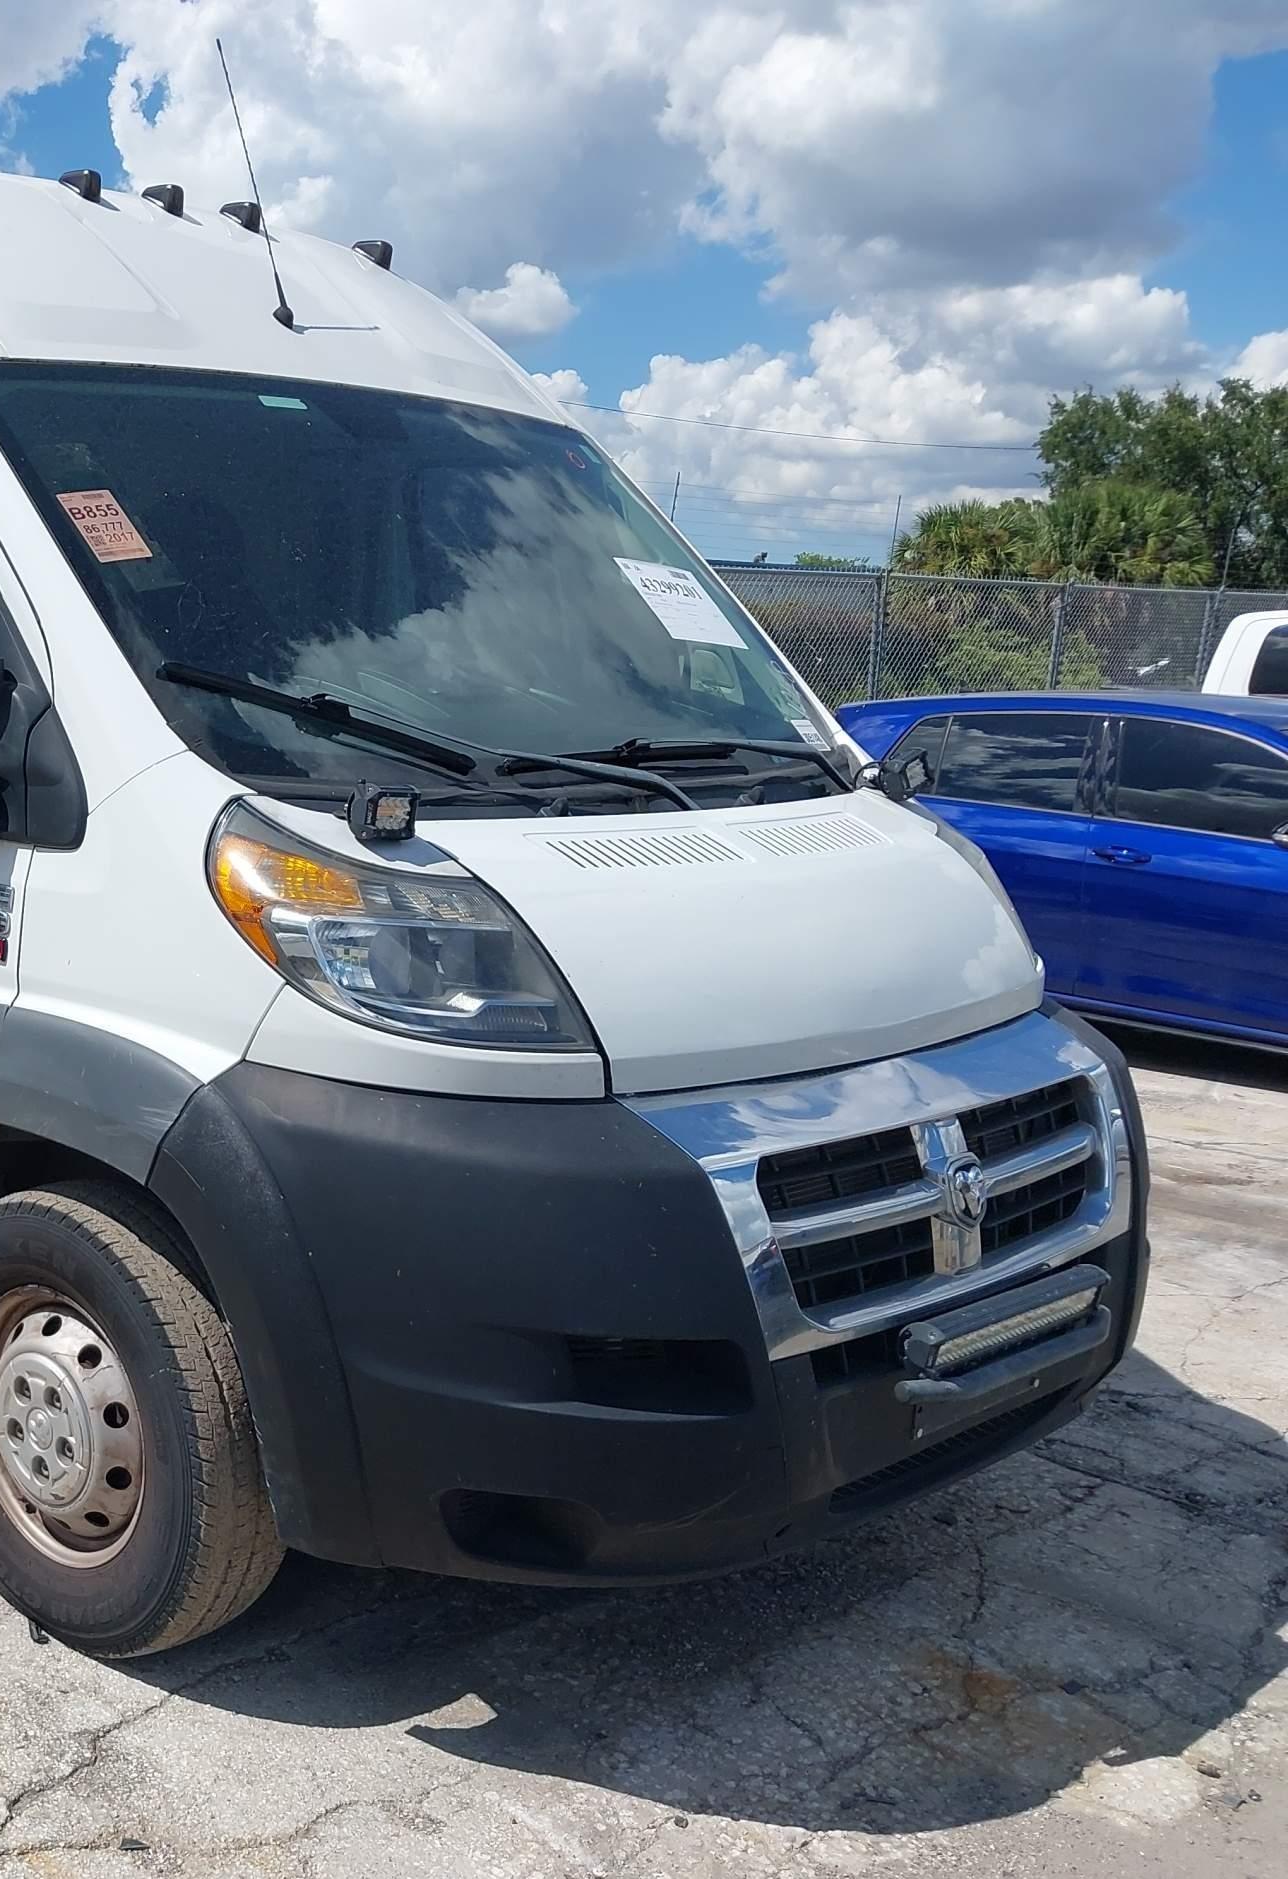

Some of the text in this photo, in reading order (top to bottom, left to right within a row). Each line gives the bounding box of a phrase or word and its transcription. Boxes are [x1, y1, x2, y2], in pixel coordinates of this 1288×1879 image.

[68, 503, 120, 521] B855
[83, 521, 124, 534] 86,777
[104, 531, 136, 544] 2017
[639, 576, 703, 601] 43299201
